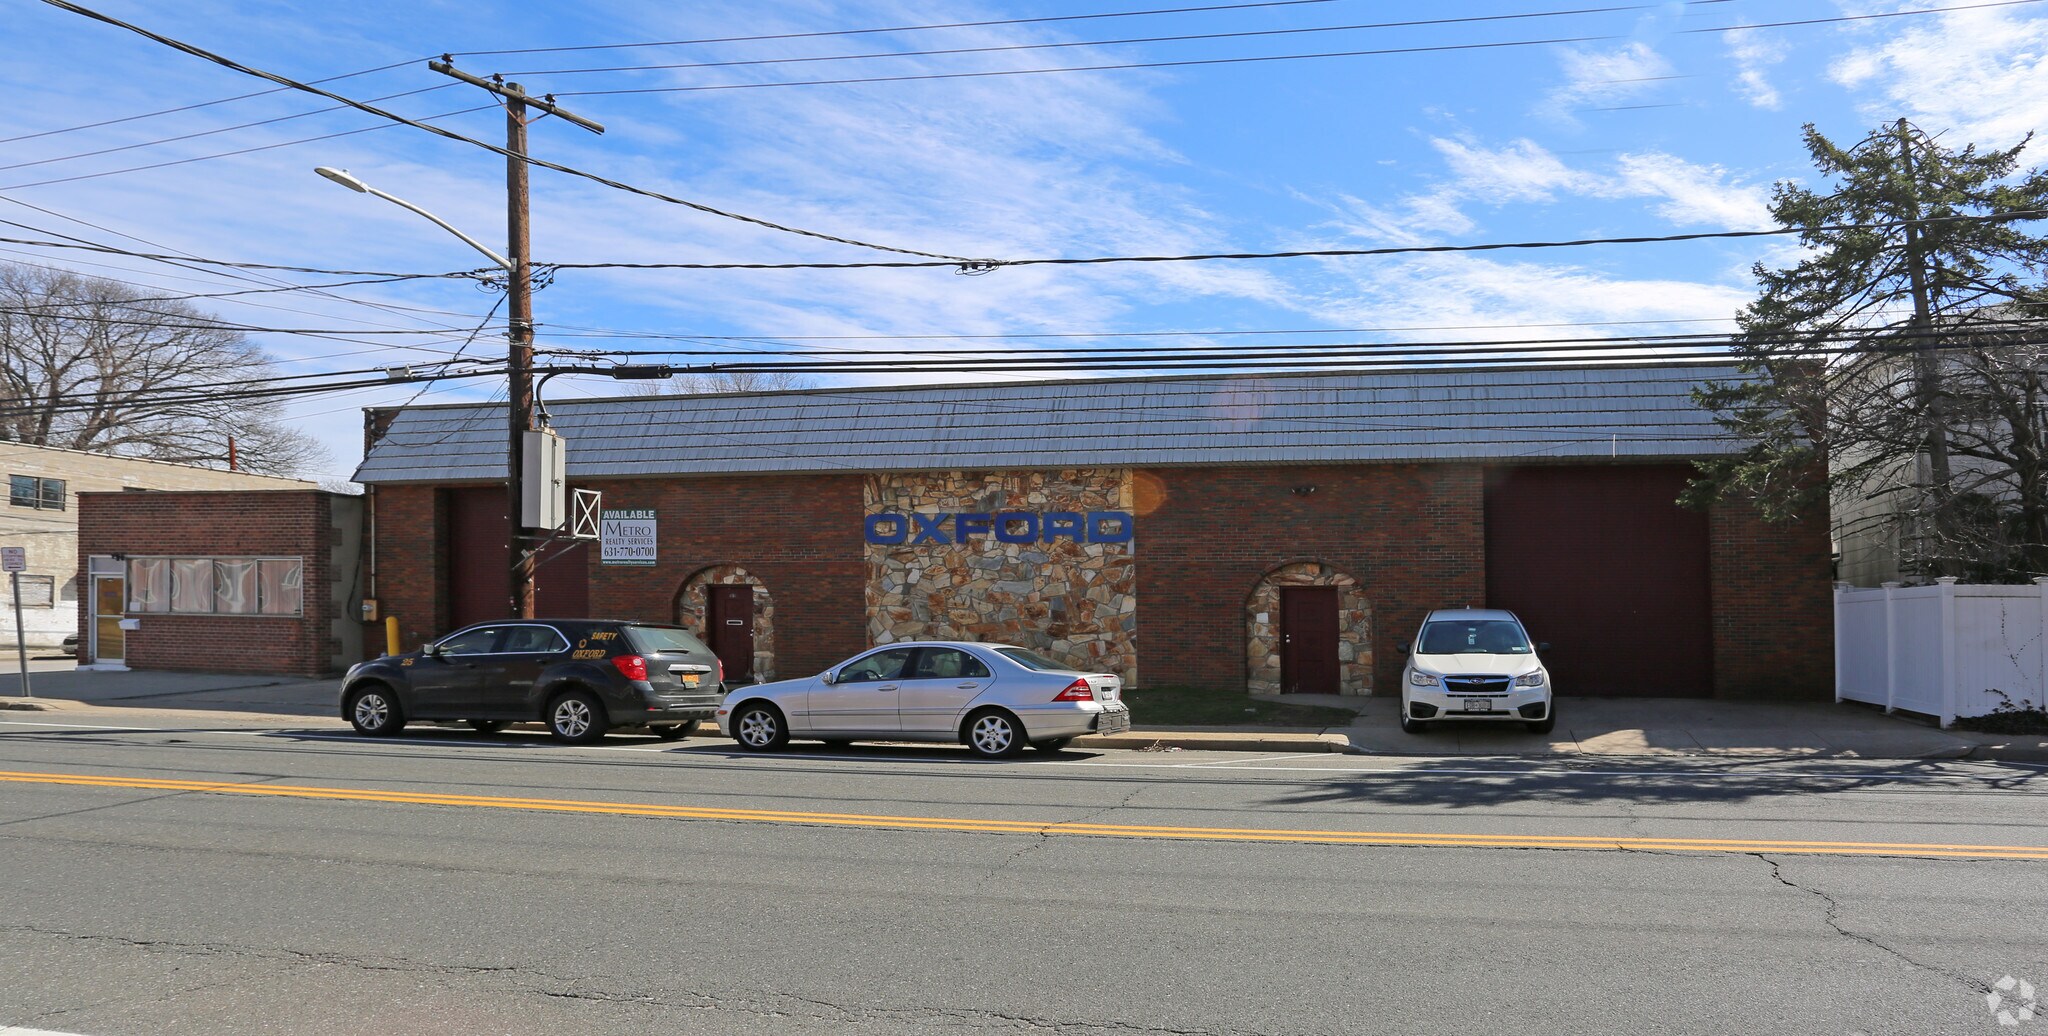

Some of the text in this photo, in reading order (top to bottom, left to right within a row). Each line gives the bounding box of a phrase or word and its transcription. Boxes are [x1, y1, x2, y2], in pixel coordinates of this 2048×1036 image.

[604, 510, 654, 518] AVAILABLE
[864, 512, 1133, 545] OXFORD
[591, 632, 618, 640] SAFETY
[572, 649, 606, 659] OXFORD
[401, 658, 414, 666] 25
